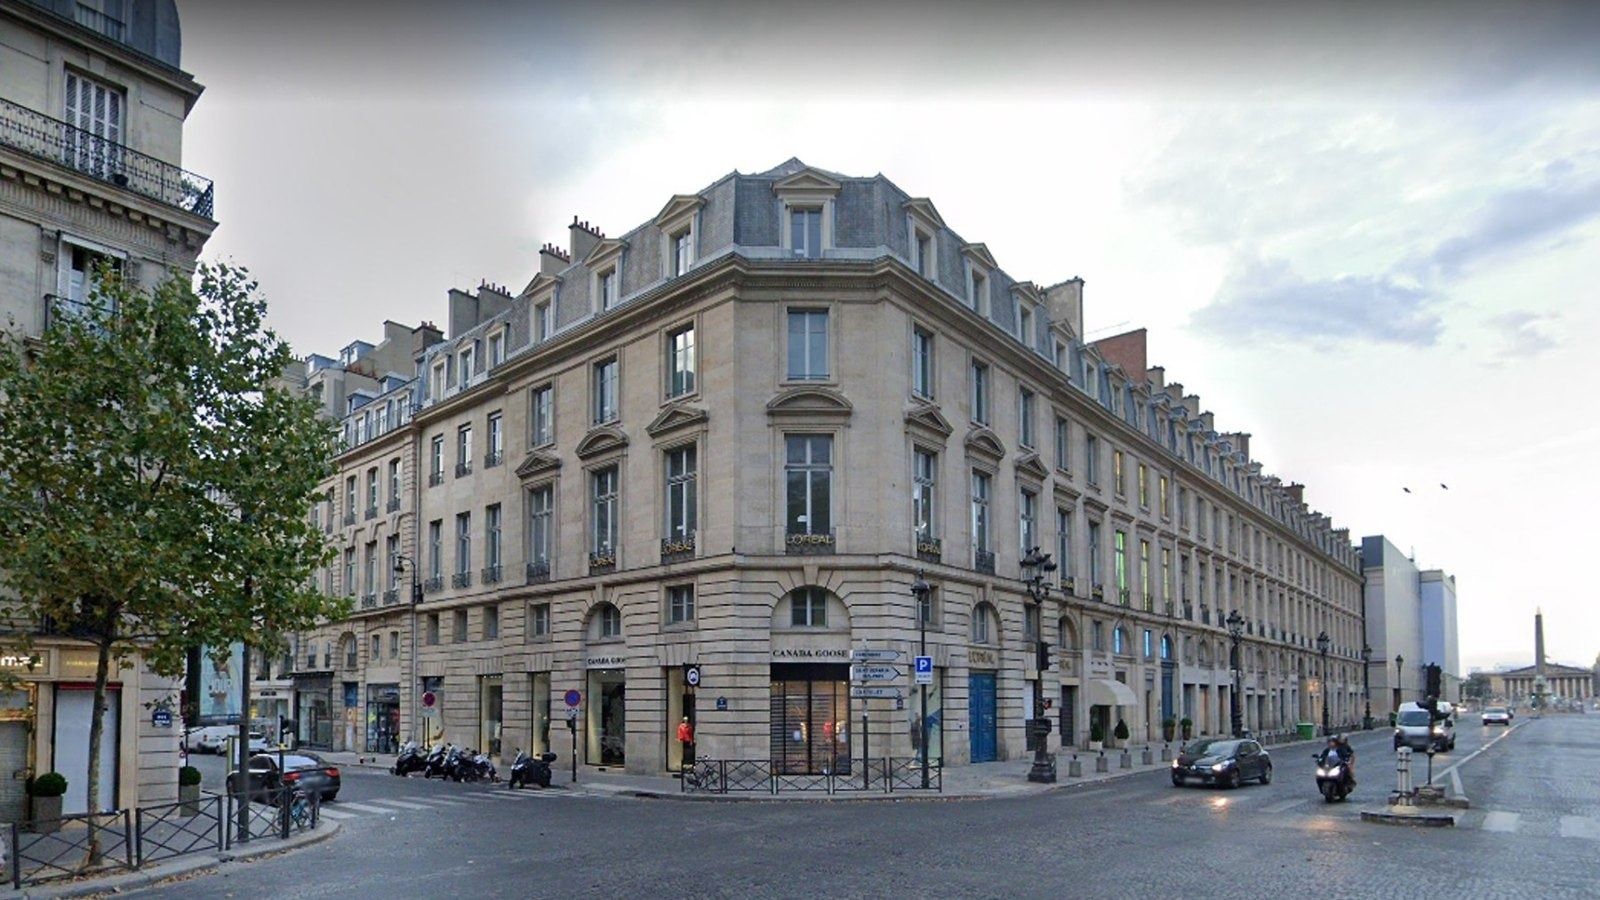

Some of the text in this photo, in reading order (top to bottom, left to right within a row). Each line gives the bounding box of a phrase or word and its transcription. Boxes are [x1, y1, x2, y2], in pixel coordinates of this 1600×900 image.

[772, 649, 812, 657] CANADA
[815, 649, 848, 657] GOOSE
[919, 659, 928, 671] P
